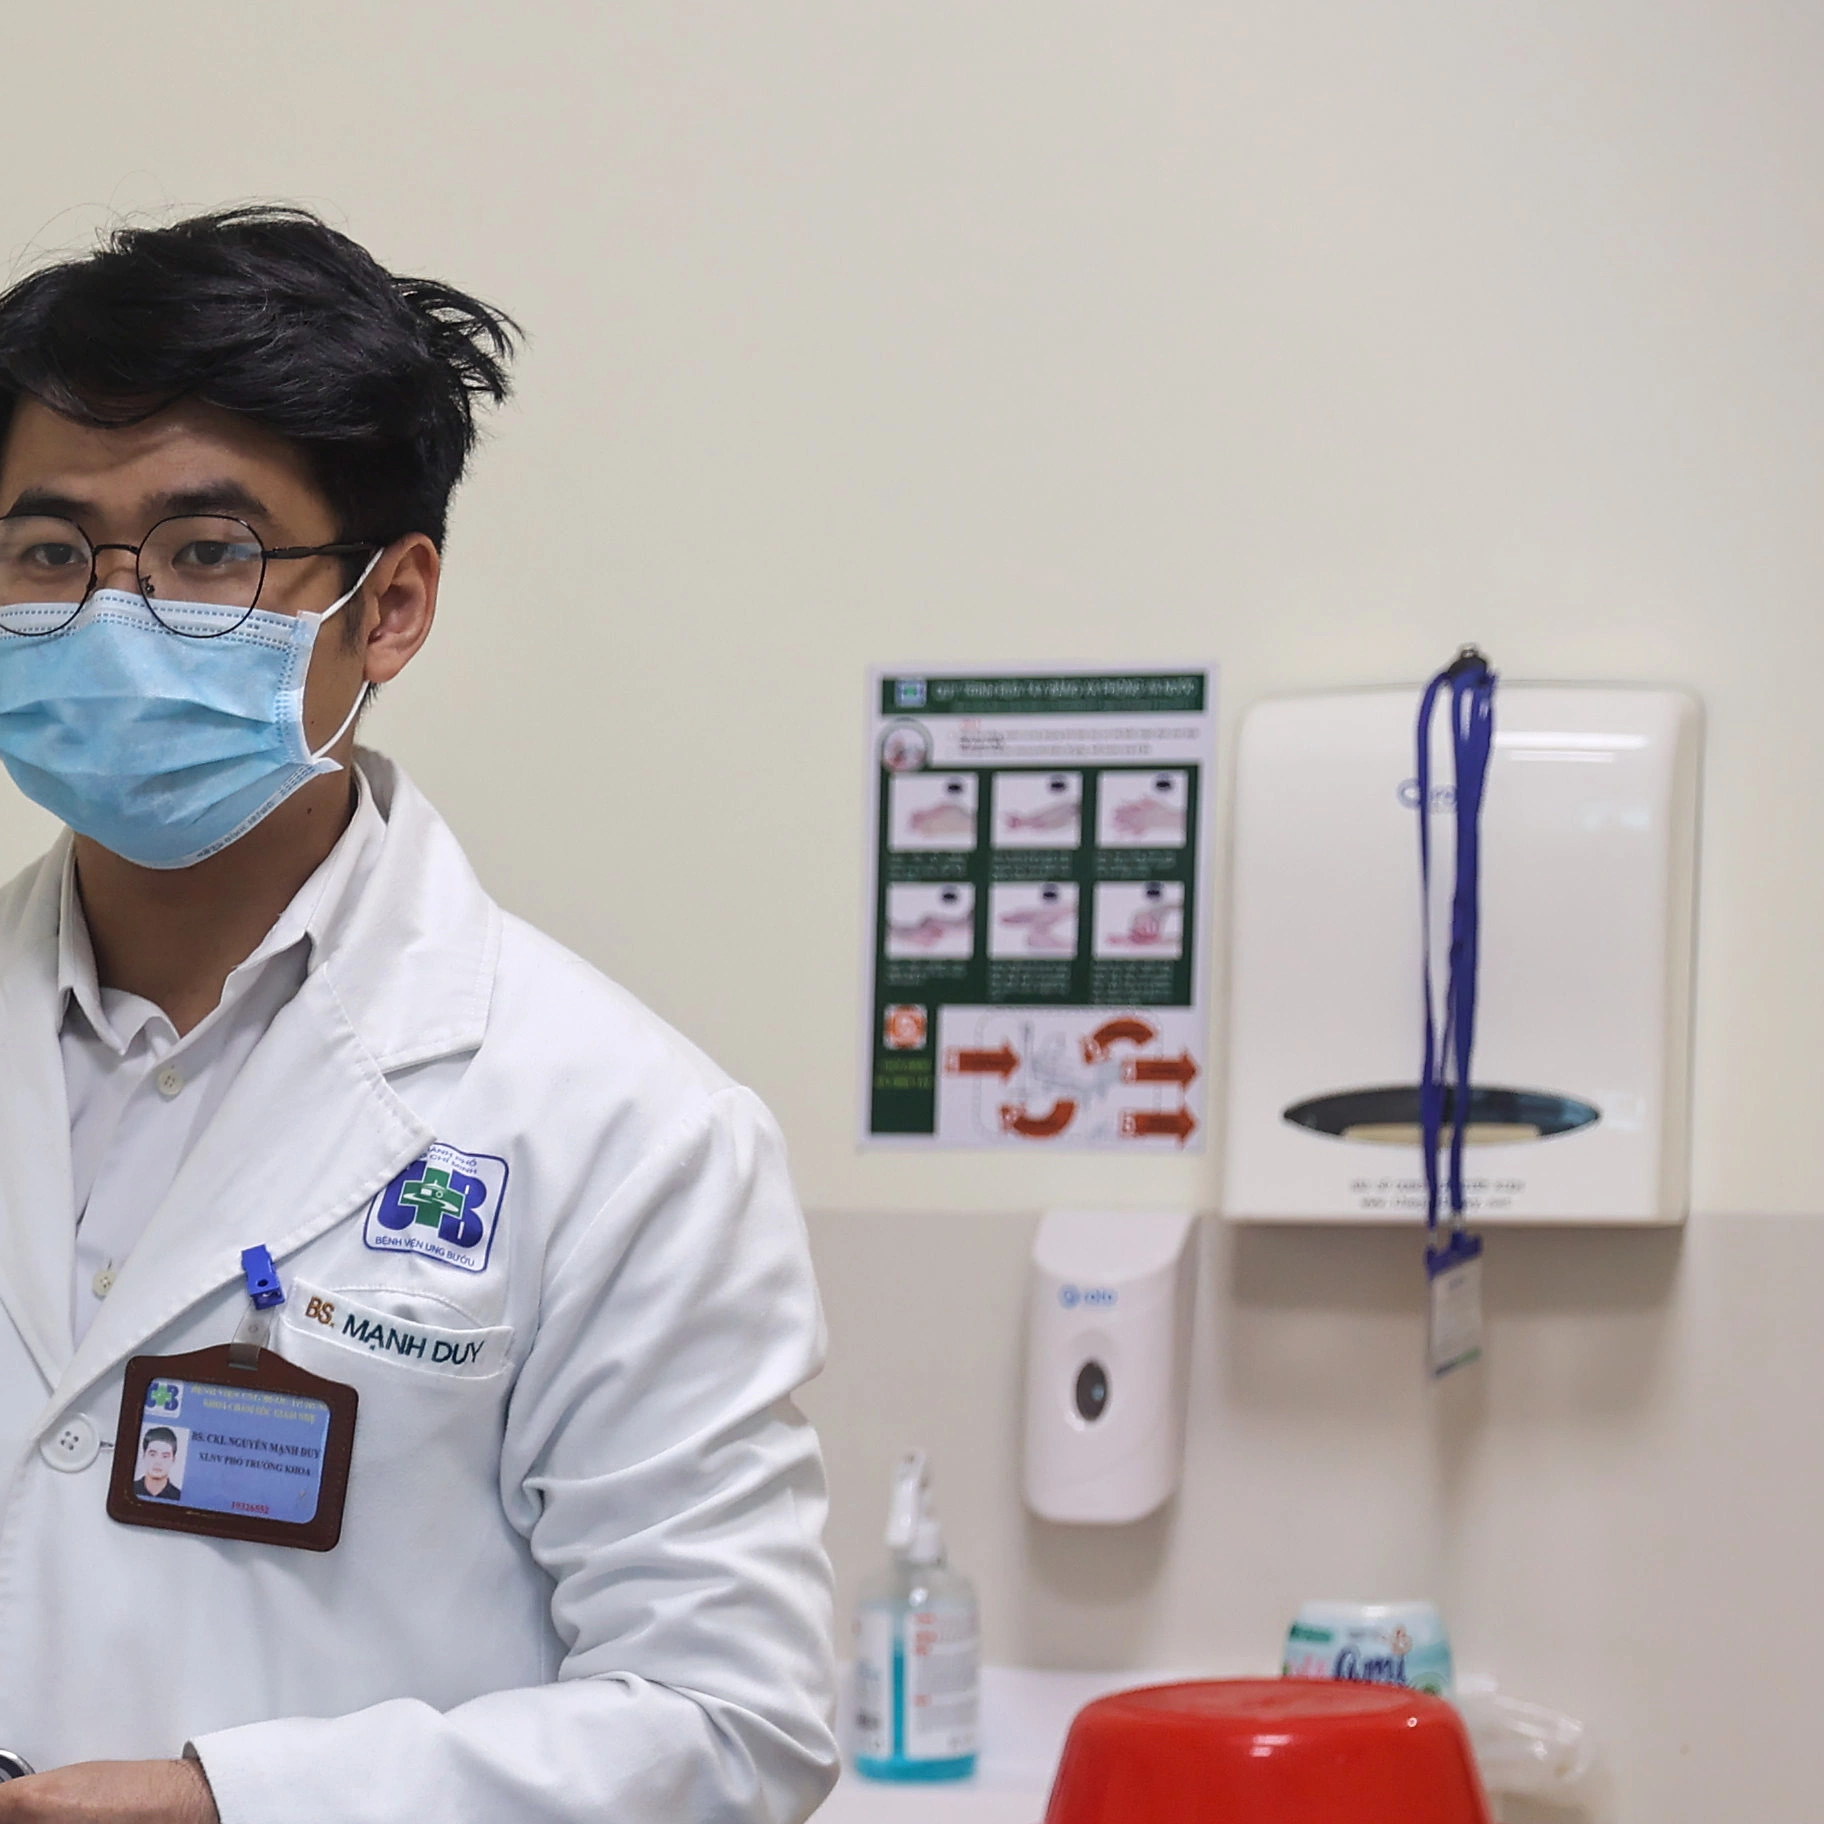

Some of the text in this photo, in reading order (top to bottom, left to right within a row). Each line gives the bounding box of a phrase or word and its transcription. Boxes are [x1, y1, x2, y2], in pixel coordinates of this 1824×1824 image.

[304, 1295, 485, 1366] BS. MẠNH DUY
